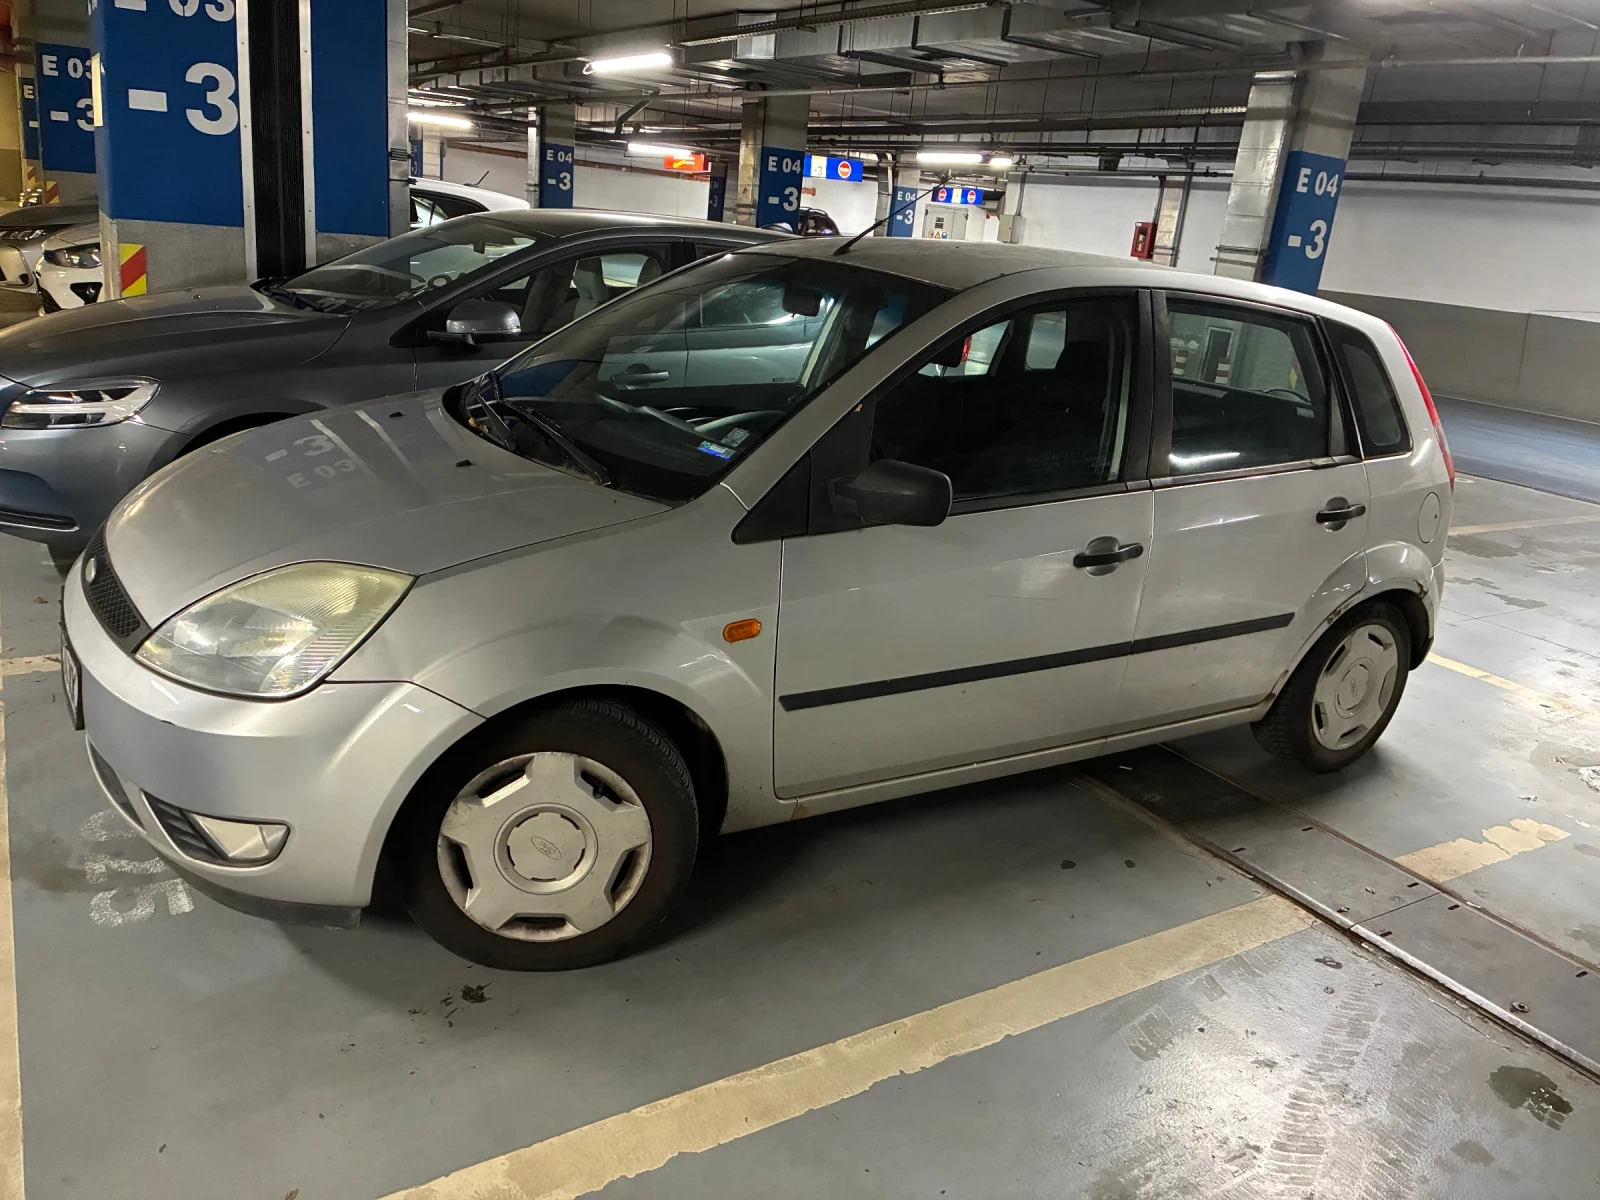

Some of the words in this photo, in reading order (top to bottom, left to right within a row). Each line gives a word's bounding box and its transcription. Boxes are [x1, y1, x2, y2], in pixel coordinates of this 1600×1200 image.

[42, 54, 59, 76] E
[23, 84, 35, 99] E
[546, 149, 555, 161] E
[557, 151, 573, 164] 04
[768, 156, 778, 172] E
[782, 158, 801, 174] 04
[1296, 167, 1312, 194] E
[1314, 171, 1339, 198] 04
[897, 191, 904, 201] E
[905, 192, 917, 202] 04
